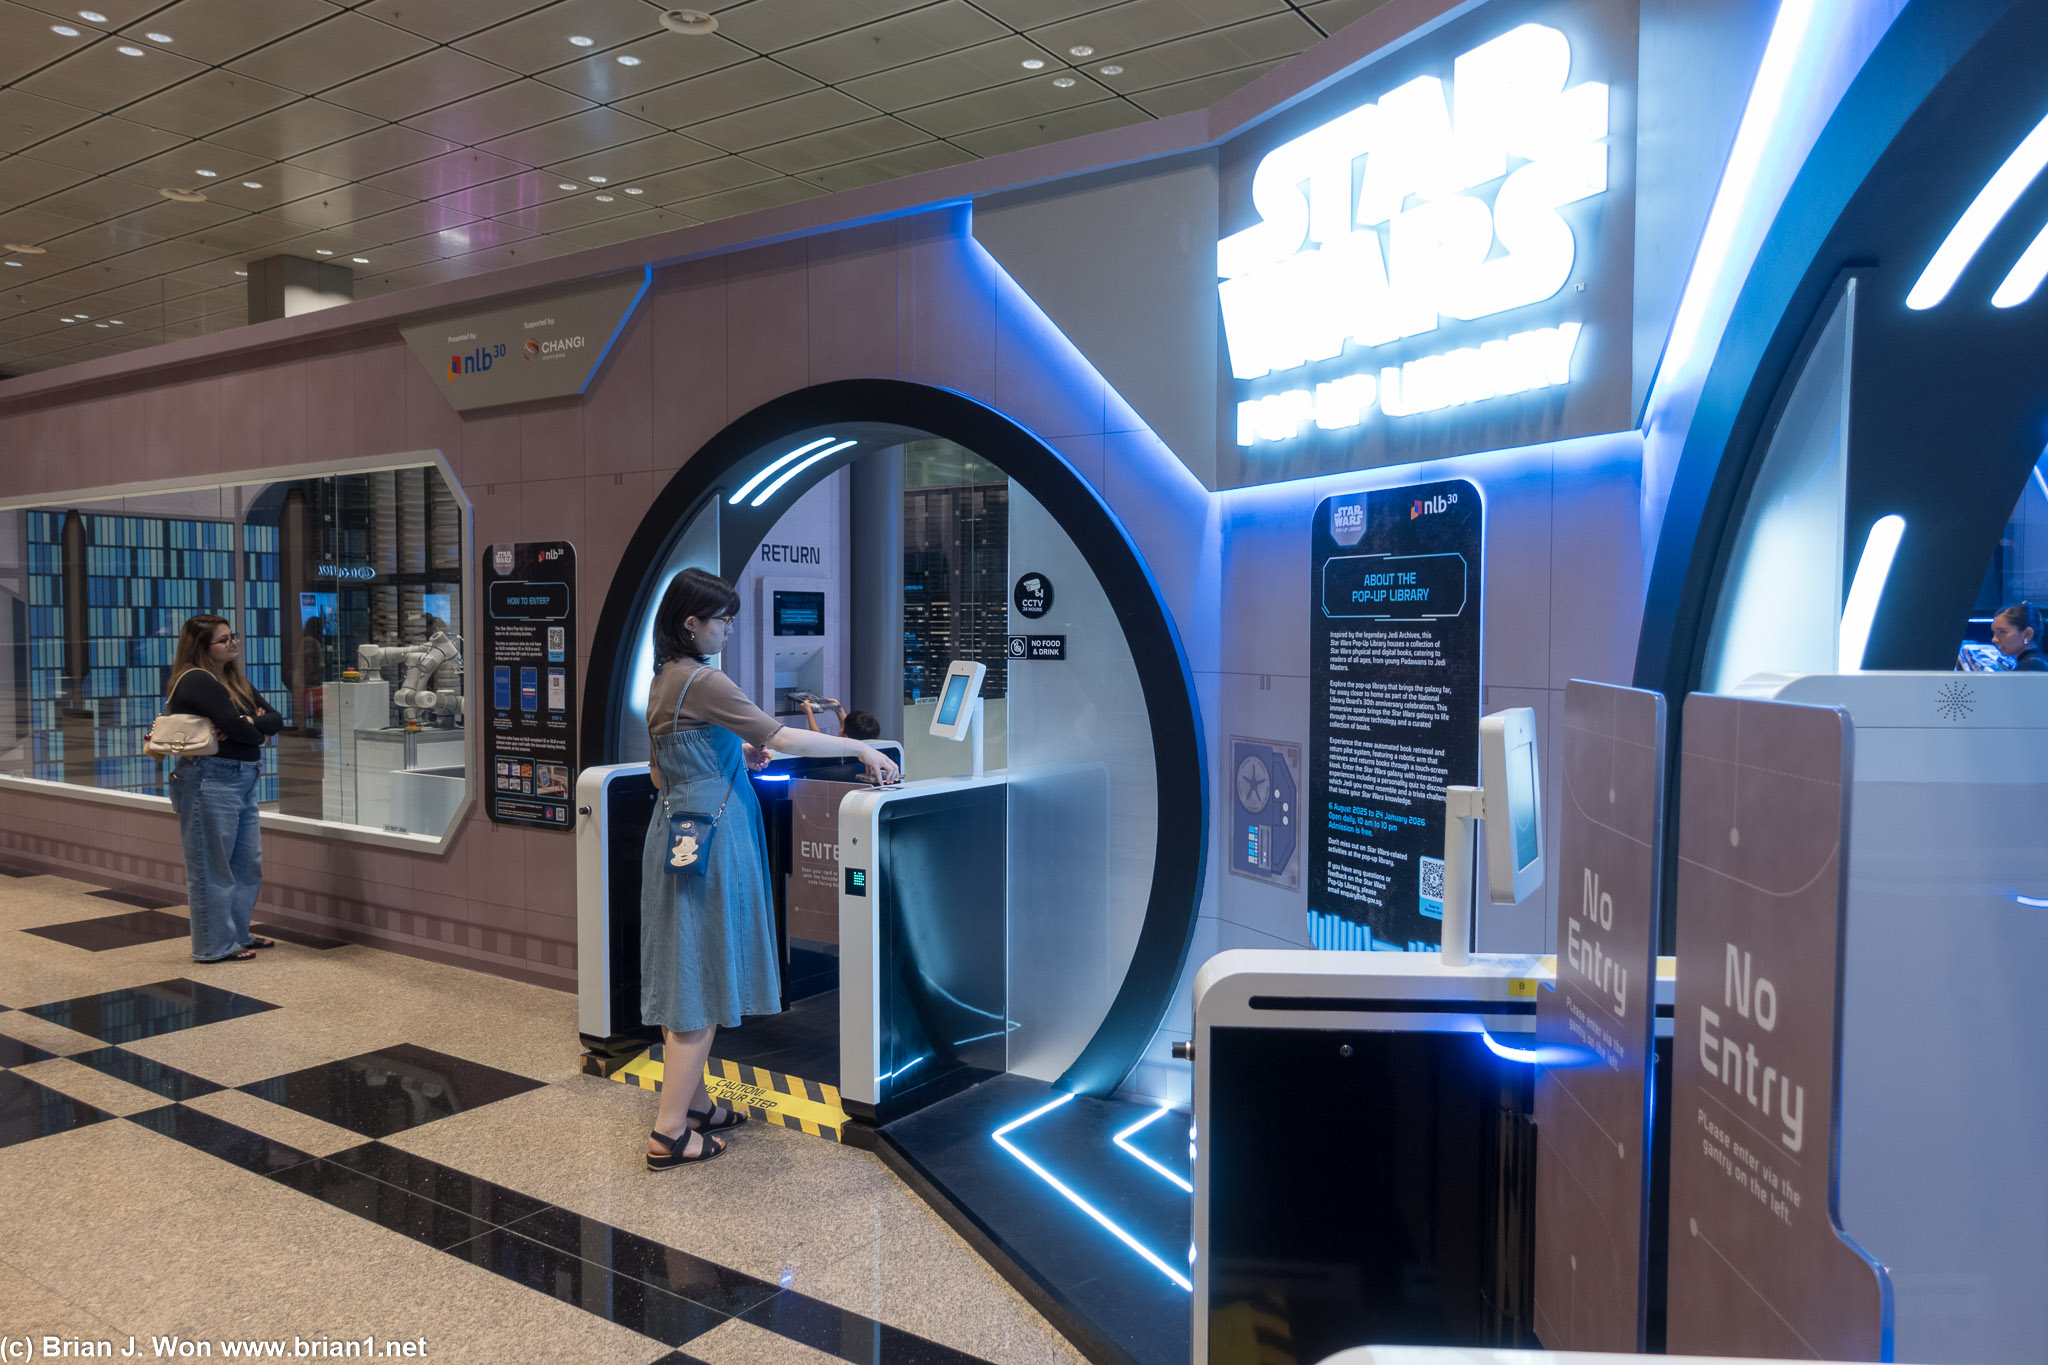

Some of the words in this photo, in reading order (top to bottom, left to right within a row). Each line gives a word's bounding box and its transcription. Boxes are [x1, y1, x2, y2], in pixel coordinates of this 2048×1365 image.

[524, 318, 546, 328] Supported
[548, 317, 554, 325] by
[542, 336, 584, 353] CHANGI
[1334, 505, 1363, 517] STAR
[1334, 515, 1363, 527] WARS
[762, 543, 820, 564] RETURN
[1364, 573, 1395, 586] ABOUT
[1397, 572, 1416, 584] THE
[529, 596, 550, 604] ENTER?
[1352, 590, 1387, 603] POP-UP
[1390, 588, 1429, 601] LIBRARY
[1372, 682, 1387, 691] library
[1399, 684, 1414, 692] brings
[1424, 685, 1441, 694] galaxy
[1443, 686, 1452, 695] far,
[1328, 812, 1342, 820] Open
[1343, 814, 1356, 824] daily,
[1333, 804, 1351, 813] August
[1352, 806, 1367, 816] 2025
[1375, 810, 1383, 818] 24
[1384, 812, 1407, 824] January
[1408, 816, 1426, 826] 2026
[1328, 821, 1354, 832] Admission
[1355, 825, 1360, 834] is
[1361, 828, 1373, 836] free.
[1328, 846, 1347, 855] activities
[1362, 854, 1378, 863] pop-up
[1583, 867, 1613, 932] No
[1568, 916, 1627, 1018] Entry
[1725, 942, 1777, 1032] No
[1586, 1017, 1602, 1036] enter
[1603, 1030, 1612, 1047] via
[1614, 1039, 1624, 1058] the
[1587, 1035, 1595, 1050] on
[1700, 1004, 1803, 1152] Entry
[716, 1080, 766, 1096] CAUTION!
[718, 1089, 748, 1102] YOUR
[746, 1097, 778, 1108] STEP
[1703, 1139, 1732, 1176] gantry
[1735, 1167, 1747, 1186] on
[1750, 1176, 1767, 1204] the
[1770, 1192, 1792, 1227] left.
[1733, 1142, 1759, 1172] enter
[1762, 1165, 1778, 1189] via
[1782, 1179, 1800, 1207] the
